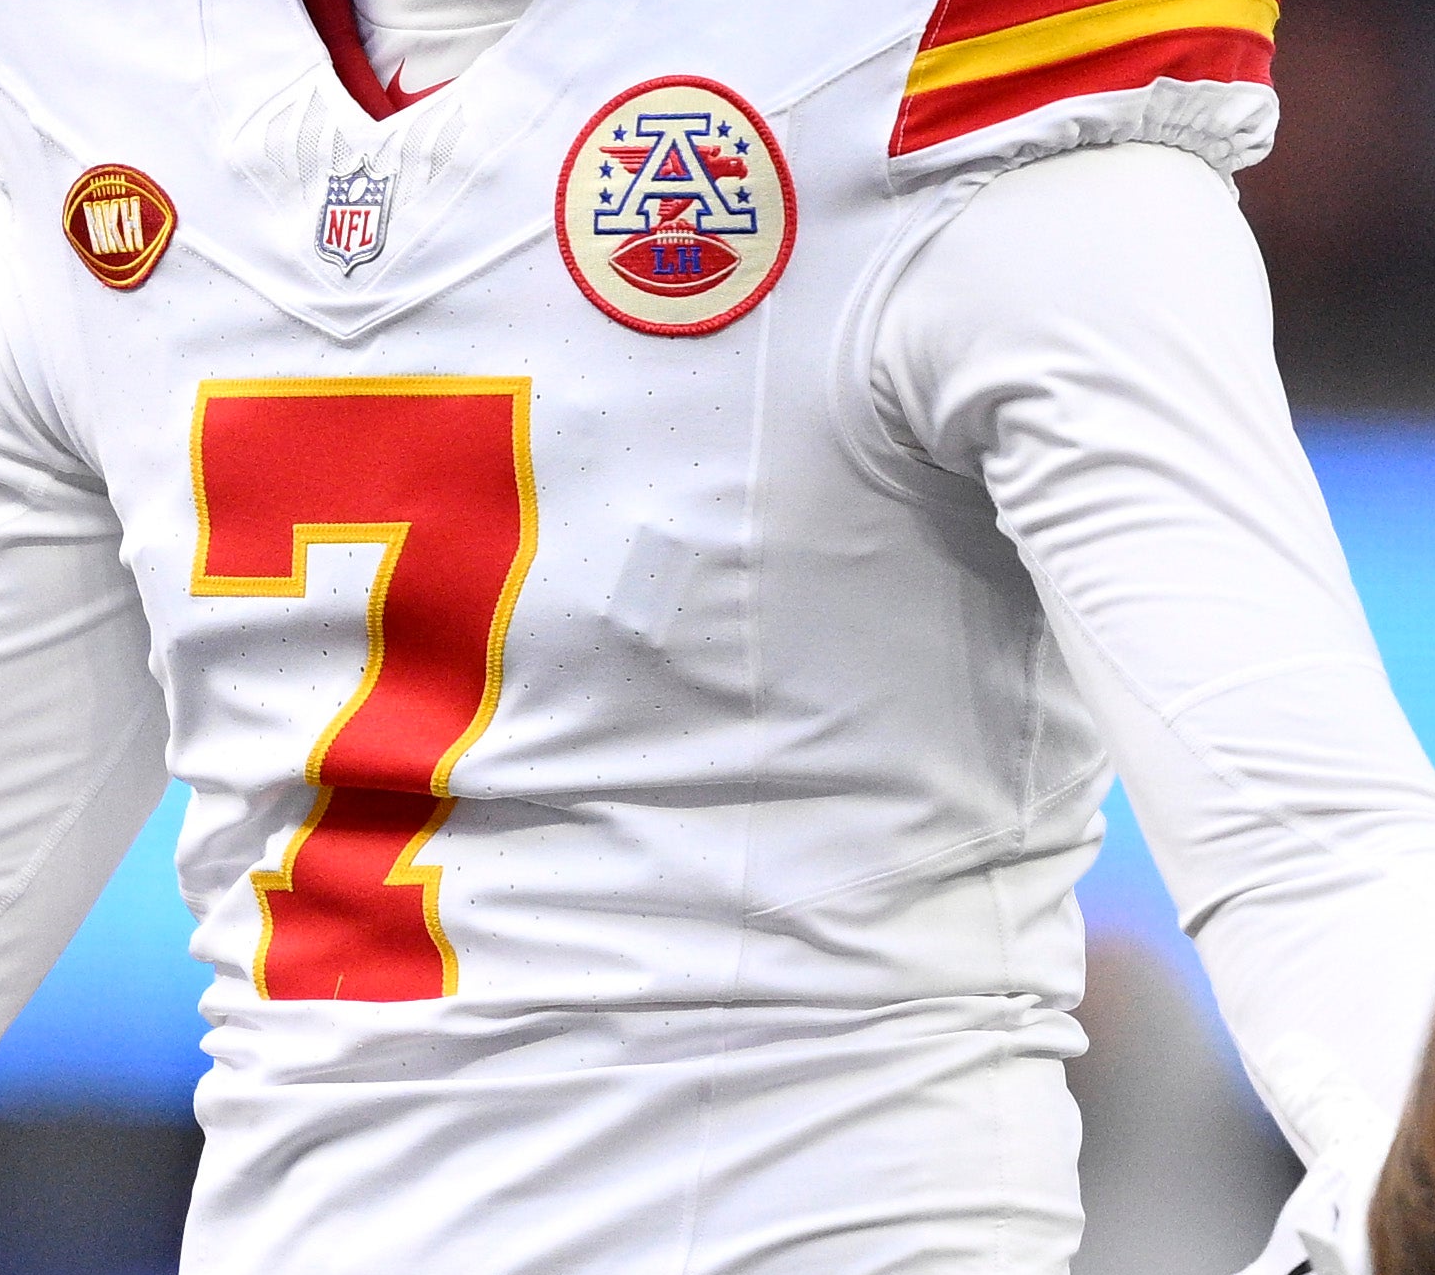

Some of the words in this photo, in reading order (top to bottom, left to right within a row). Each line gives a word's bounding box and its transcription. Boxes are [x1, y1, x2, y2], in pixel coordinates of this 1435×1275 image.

[593, 112, 758, 235] A
[325, 209, 374, 252] NFL
[651, 246, 702, 275] LH
[190, 375, 538, 1001] 7
